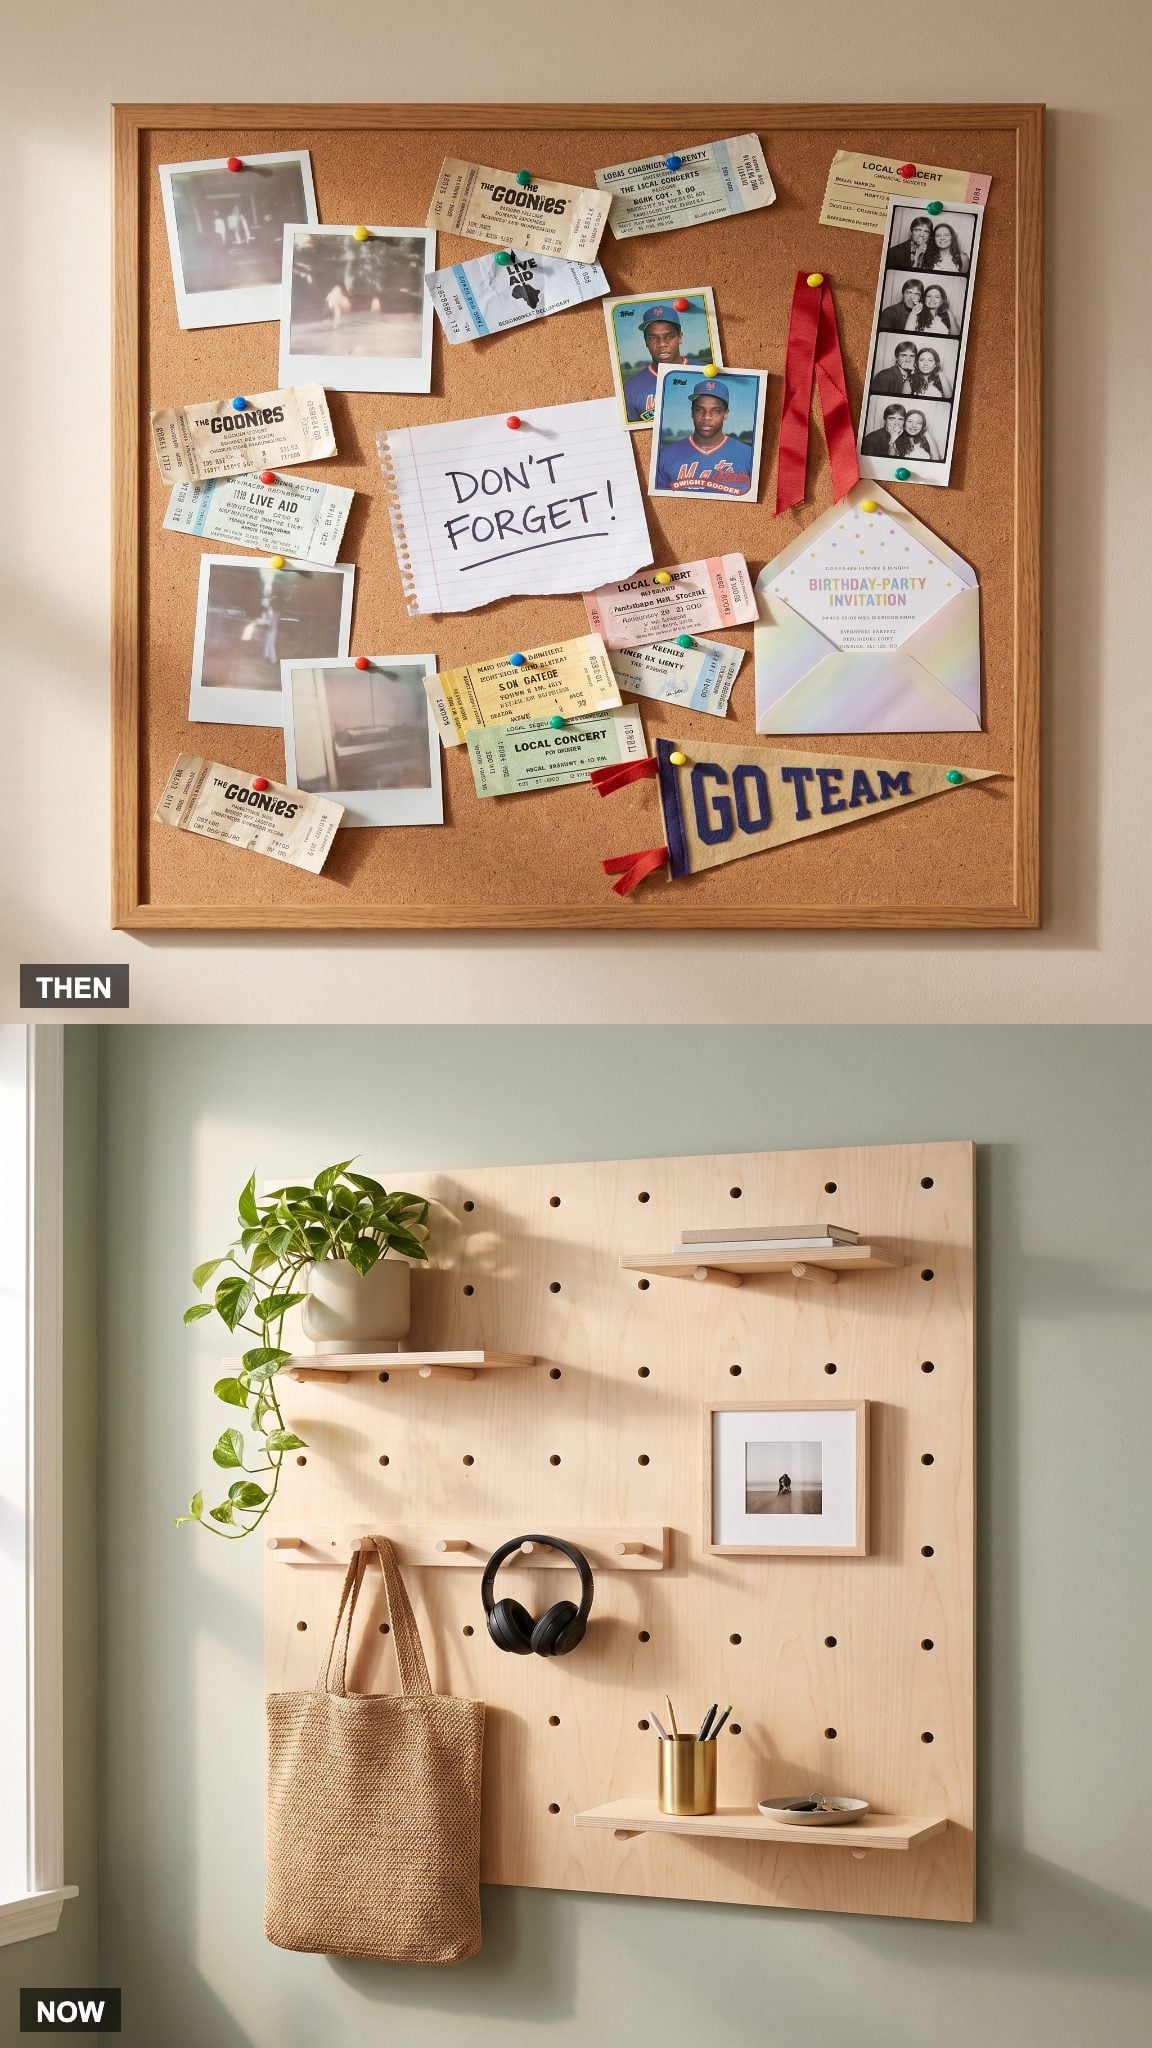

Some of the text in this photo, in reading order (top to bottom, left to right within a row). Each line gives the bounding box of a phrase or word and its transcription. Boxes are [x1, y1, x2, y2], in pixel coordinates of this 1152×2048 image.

[862, 161, 894, 174] LOCAL
[506, 258, 538, 275] LIVE
[509, 270, 534, 286] AID
[445, 453, 565, 504] DON'T
[673, 480, 740, 495] DWIGHT GOODEN
[249, 493, 298, 513] LIVE AID
[617, 580, 650, 592] LOCAL
[809, 577, 927, 591] BIRTHDAY-PARTY
[829, 593, 907, 607] INVITATION
[514, 730, 607, 753] LOCAL CONCERT
[690, 762, 914, 845] GO TEAM
